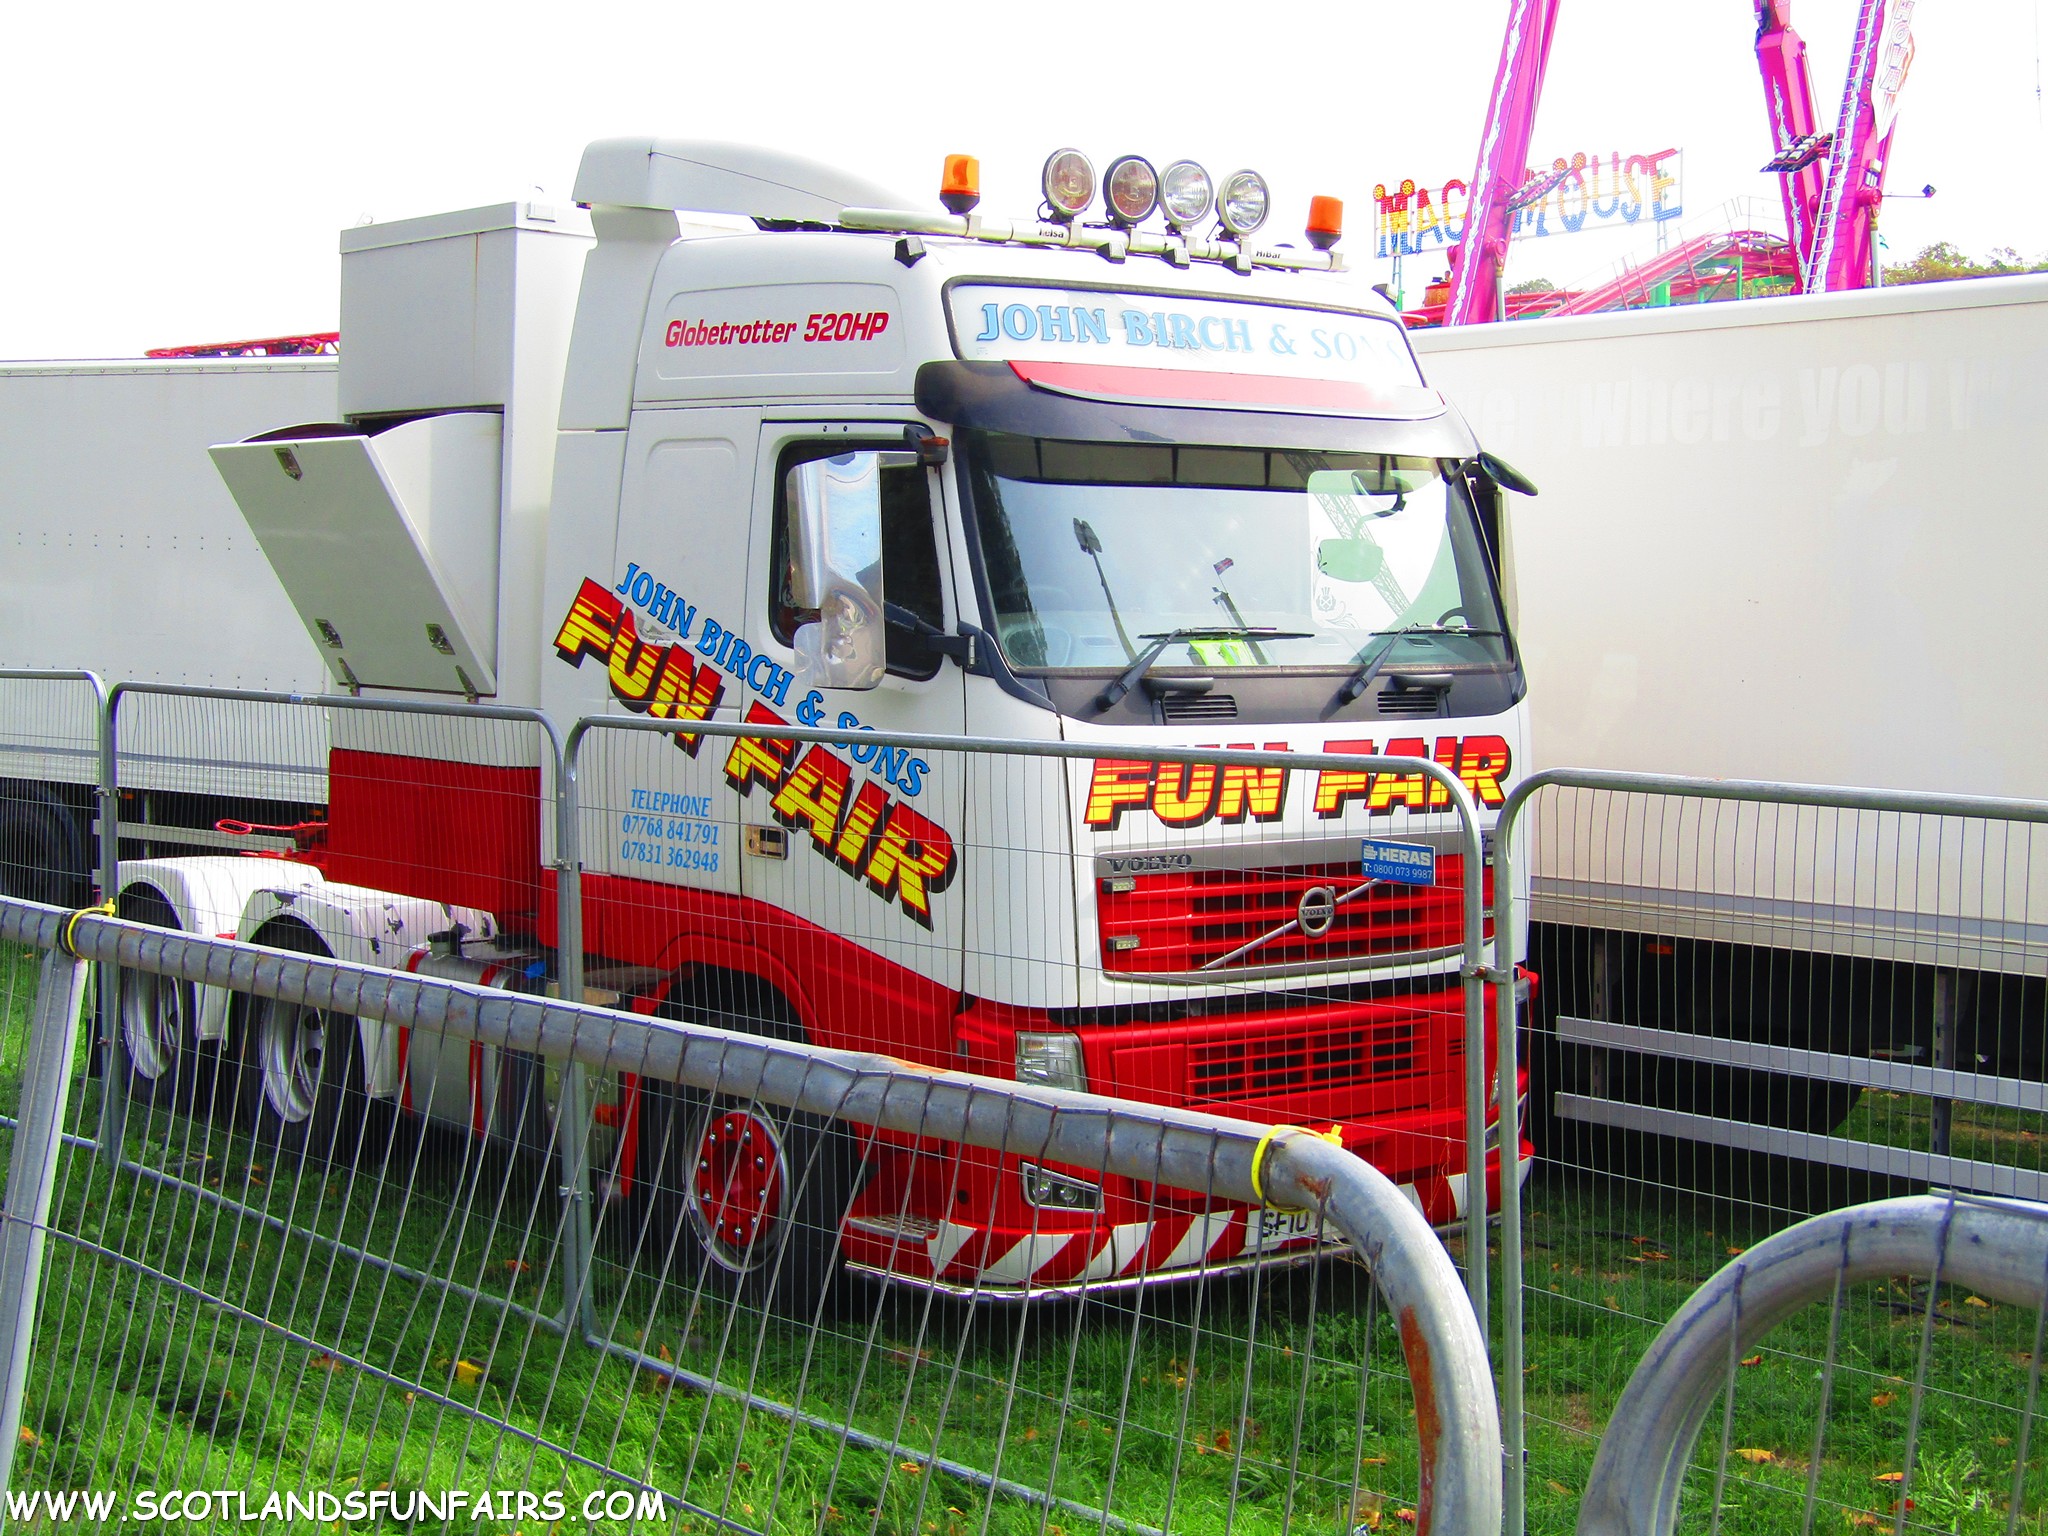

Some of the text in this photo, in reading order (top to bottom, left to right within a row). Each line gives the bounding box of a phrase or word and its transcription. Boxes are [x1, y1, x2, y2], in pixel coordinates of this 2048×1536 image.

[665, 312, 889, 347] Globetrotter 520HP
[977, 302, 1110, 344] JOHN
[1121, 310, 1254, 355] BIRCH
[1269, 323, 1297, 357] &
[1798, 362, 1926, 448] you
[615, 562, 931, 797] JOHN BIRCH & SONS
[553, 576, 958, 932] FUN FAIR
[1083, 735, 1512, 832] FUN FAIR
[631, 789, 712, 817] TELEPHONE
[622, 814, 719, 846] 07768 841791
[621, 840, 719, 873] 07831 362948
[1107, 854, 1192, 873] VOLVO
[1363, 862, 1433, 880] T: 0800 073 9987
[1379, 848, 1431, 867] HERAS
[1301, 908, 1334, 917] VOLVO
